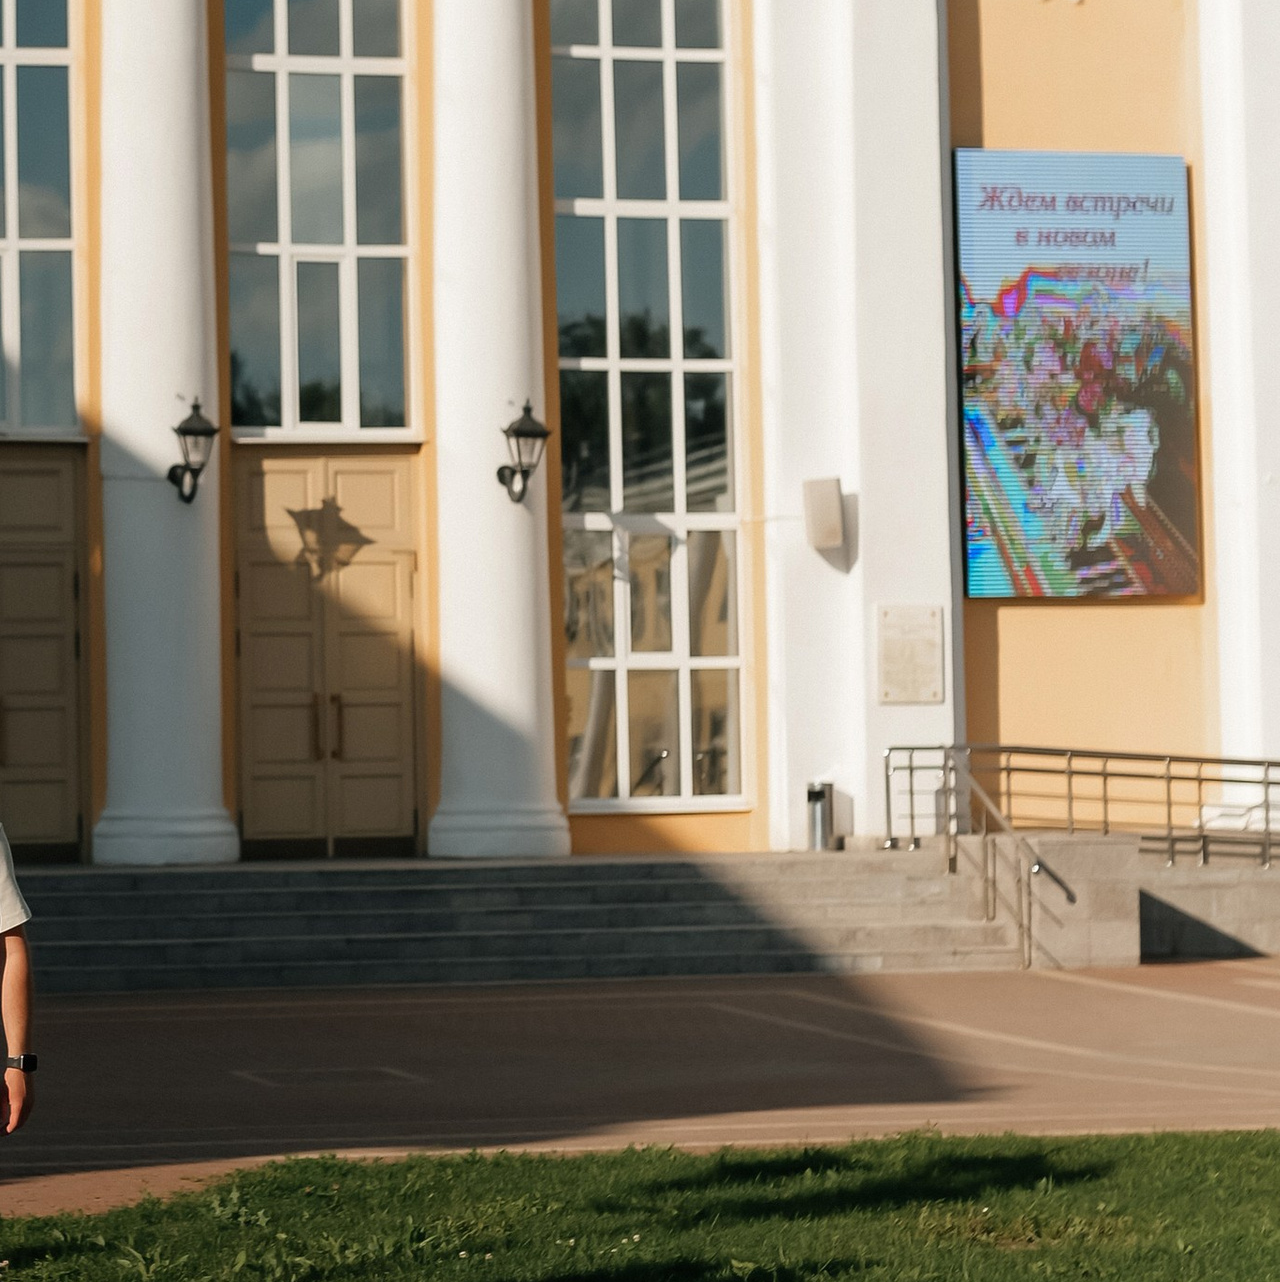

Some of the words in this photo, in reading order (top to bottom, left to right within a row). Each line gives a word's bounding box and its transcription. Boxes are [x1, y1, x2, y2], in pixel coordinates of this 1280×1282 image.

[978, 185, 1057, 212] Ждем
[1066, 192, 1174, 220] встречи
[1016, 230, 1029, 246] в
[1036, 229, 1116, 247] новом
